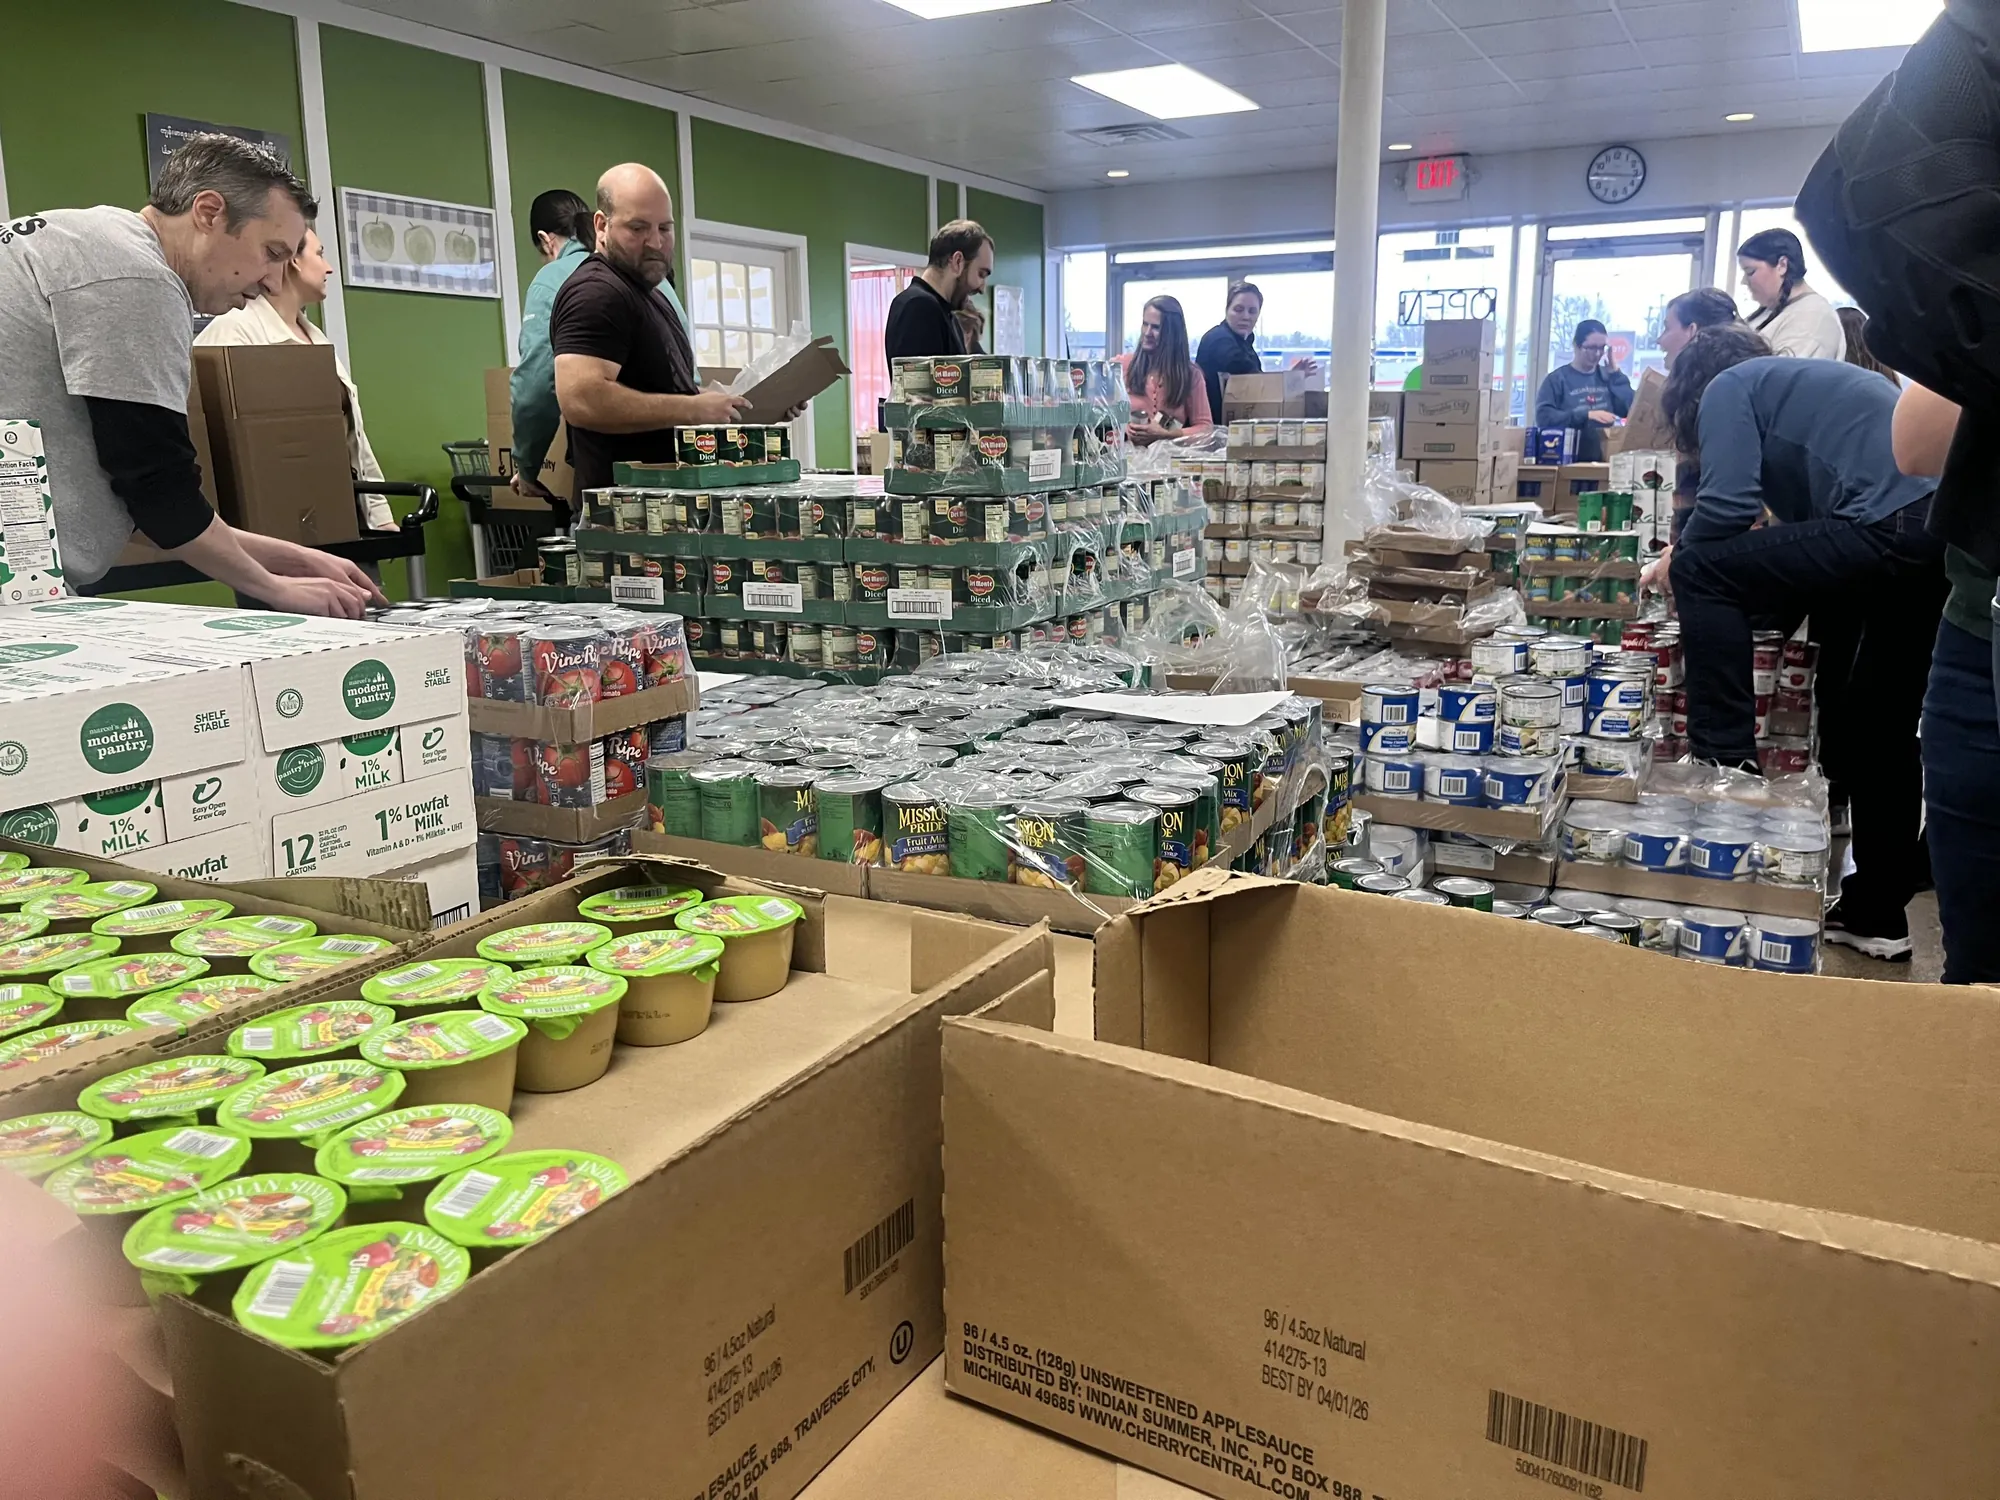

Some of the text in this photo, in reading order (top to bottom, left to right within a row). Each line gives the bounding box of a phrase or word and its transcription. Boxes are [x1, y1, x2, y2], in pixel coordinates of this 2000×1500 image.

[1417, 160, 1455, 190] EXIT
[936, 386, 958, 395] Diced
[864, 590, 886, 598] Diced
[977, 580, 993, 588] Monte
[970, 595, 991, 603] Diced
[611, 637, 643, 659] Ripe
[646, 634, 678, 656] Vine
[541, 652, 581, 673] Vine
[424, 676, 451, 688] STABLE
[426, 668, 449, 680] SHELF
[347, 681, 389, 697] modern
[354, 692, 392, 707] pantry
[193, 719, 230, 734] STABLE
[195, 710, 227, 724] SHELF
[87, 728, 145, 748] modern
[609, 737, 642, 758] Ripe
[97, 739, 149, 760] pantry
[422, 748, 447, 759] Easy Open
[436, 754, 448, 763] Cap
[361, 758, 381, 773] 1%
[355, 769, 391, 789] MILK
[192, 801, 226, 816] Easy Open
[193, 809, 227, 822] Screw Cap
[374, 794, 450, 841] 1% Lowfat
[899, 805, 948, 830] MISSION
[29, 816, 56, 833] fresh
[109, 817, 135, 834] 1%
[414, 812, 444, 832] Milk
[910, 822, 944, 834] PRIDE
[1016, 817, 1056, 843] SSION
[101, 829, 151, 854] MILK
[366, 843, 392, 858] Vitamin
[416, 833, 425, 843] 1%
[425, 828, 446, 841] Milkfat
[451, 822, 463, 832] UHT
[906, 835, 946, 846] Fruit Mix
[281, 833, 317, 870] 12
[507, 850, 545, 870] Vine
[285, 863, 317, 877] CARTONS
[176, 1058, 252, 1074] SUMMER
[232, 1061, 377, 1113] INDIAN SUMMER
[351, 1105, 500, 1138] INDIAN SUMMER
[361, 1148, 465, 1158] Unsweetened
[1263, 1308, 1279, 1330] 96
[1287, 1317, 1321, 1347] 4.5oz
[1323, 1326, 1367, 1362] Natural
[1263, 1339, 1328, 1377] 414275-13
[963, 1322, 979, 1340] 96
[989, 1330, 1010, 1351] 4.5
[1012, 1344, 1033, 1360] oz.
[1035, 1348, 1077, 1379] (128g)
[1079, 1364, 1199, 1422] UNSWEETENED
[1202, 1409, 1314, 1466] APPLESAUCE
[1261, 1364, 1370, 1421] BEST BY 04/01/26
[707, 1403, 733, 1437] BEST
[733, 1393, 747, 1417] BY
[743, 1453, 769, 1490] BOX
[770, 1435, 793, 1465] 988,
[794, 1379, 850, 1441] TRAVERSE
[851, 1355, 876, 1388] CITY,
[963, 1340, 1056, 1388] DISTRIBUTED
[1059, 1377, 1083, 1399] BY:
[1086, 1387, 1138, 1420] INDIAN
[1142, 1407, 1217, 1451] SUMMER,
[1220, 1436, 1258, 1468] INC.,
[1263, 1452, 1287, 1475] PO
[1291, 1463, 1329, 1493] BOX
[963, 1358, 1310, 1500] MICHIGAN 49685 WWW.CHERRYCENTRAL.COM
